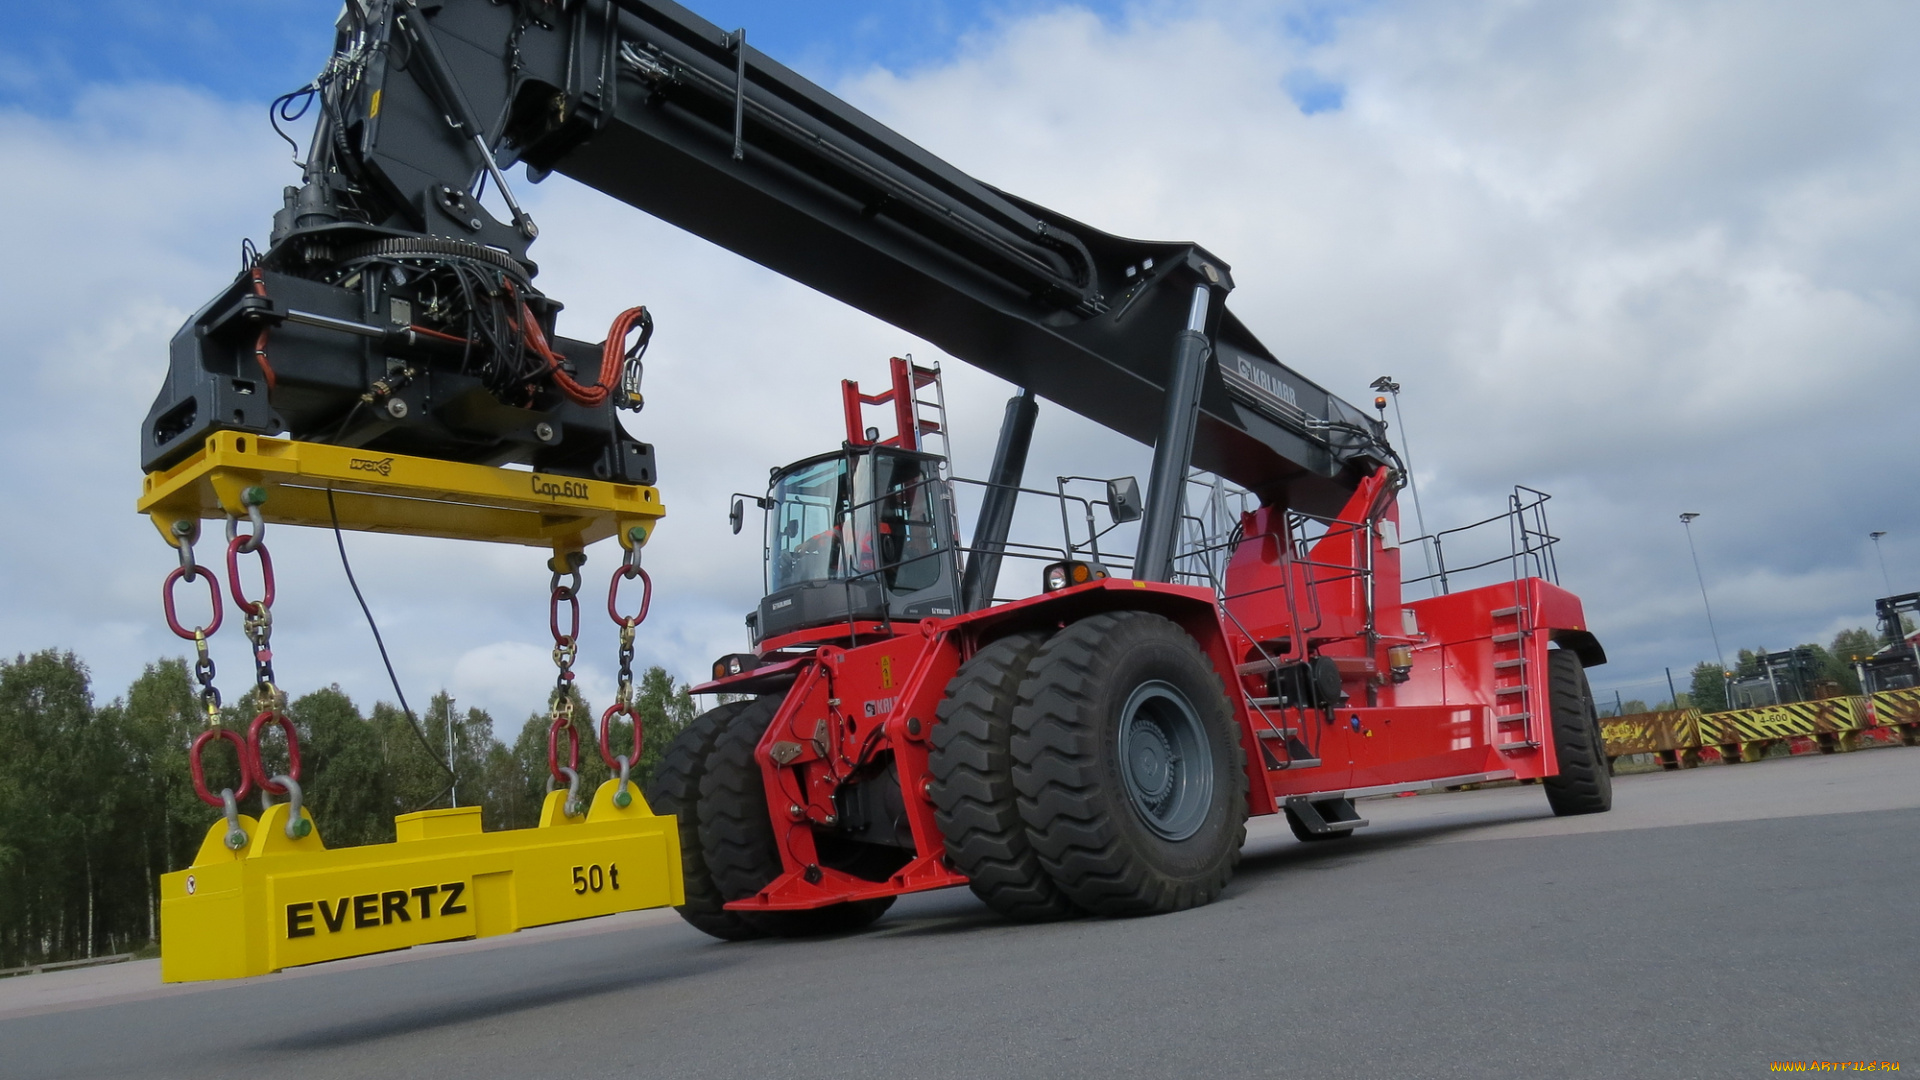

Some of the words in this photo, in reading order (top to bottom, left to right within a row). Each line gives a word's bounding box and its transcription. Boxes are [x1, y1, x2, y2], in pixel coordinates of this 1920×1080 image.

[1252, 366, 1297, 407] KALMAR
[571, 864, 604, 896] 50
[609, 862, 620, 891] t
[286, 881, 468, 939] EVERTZ
